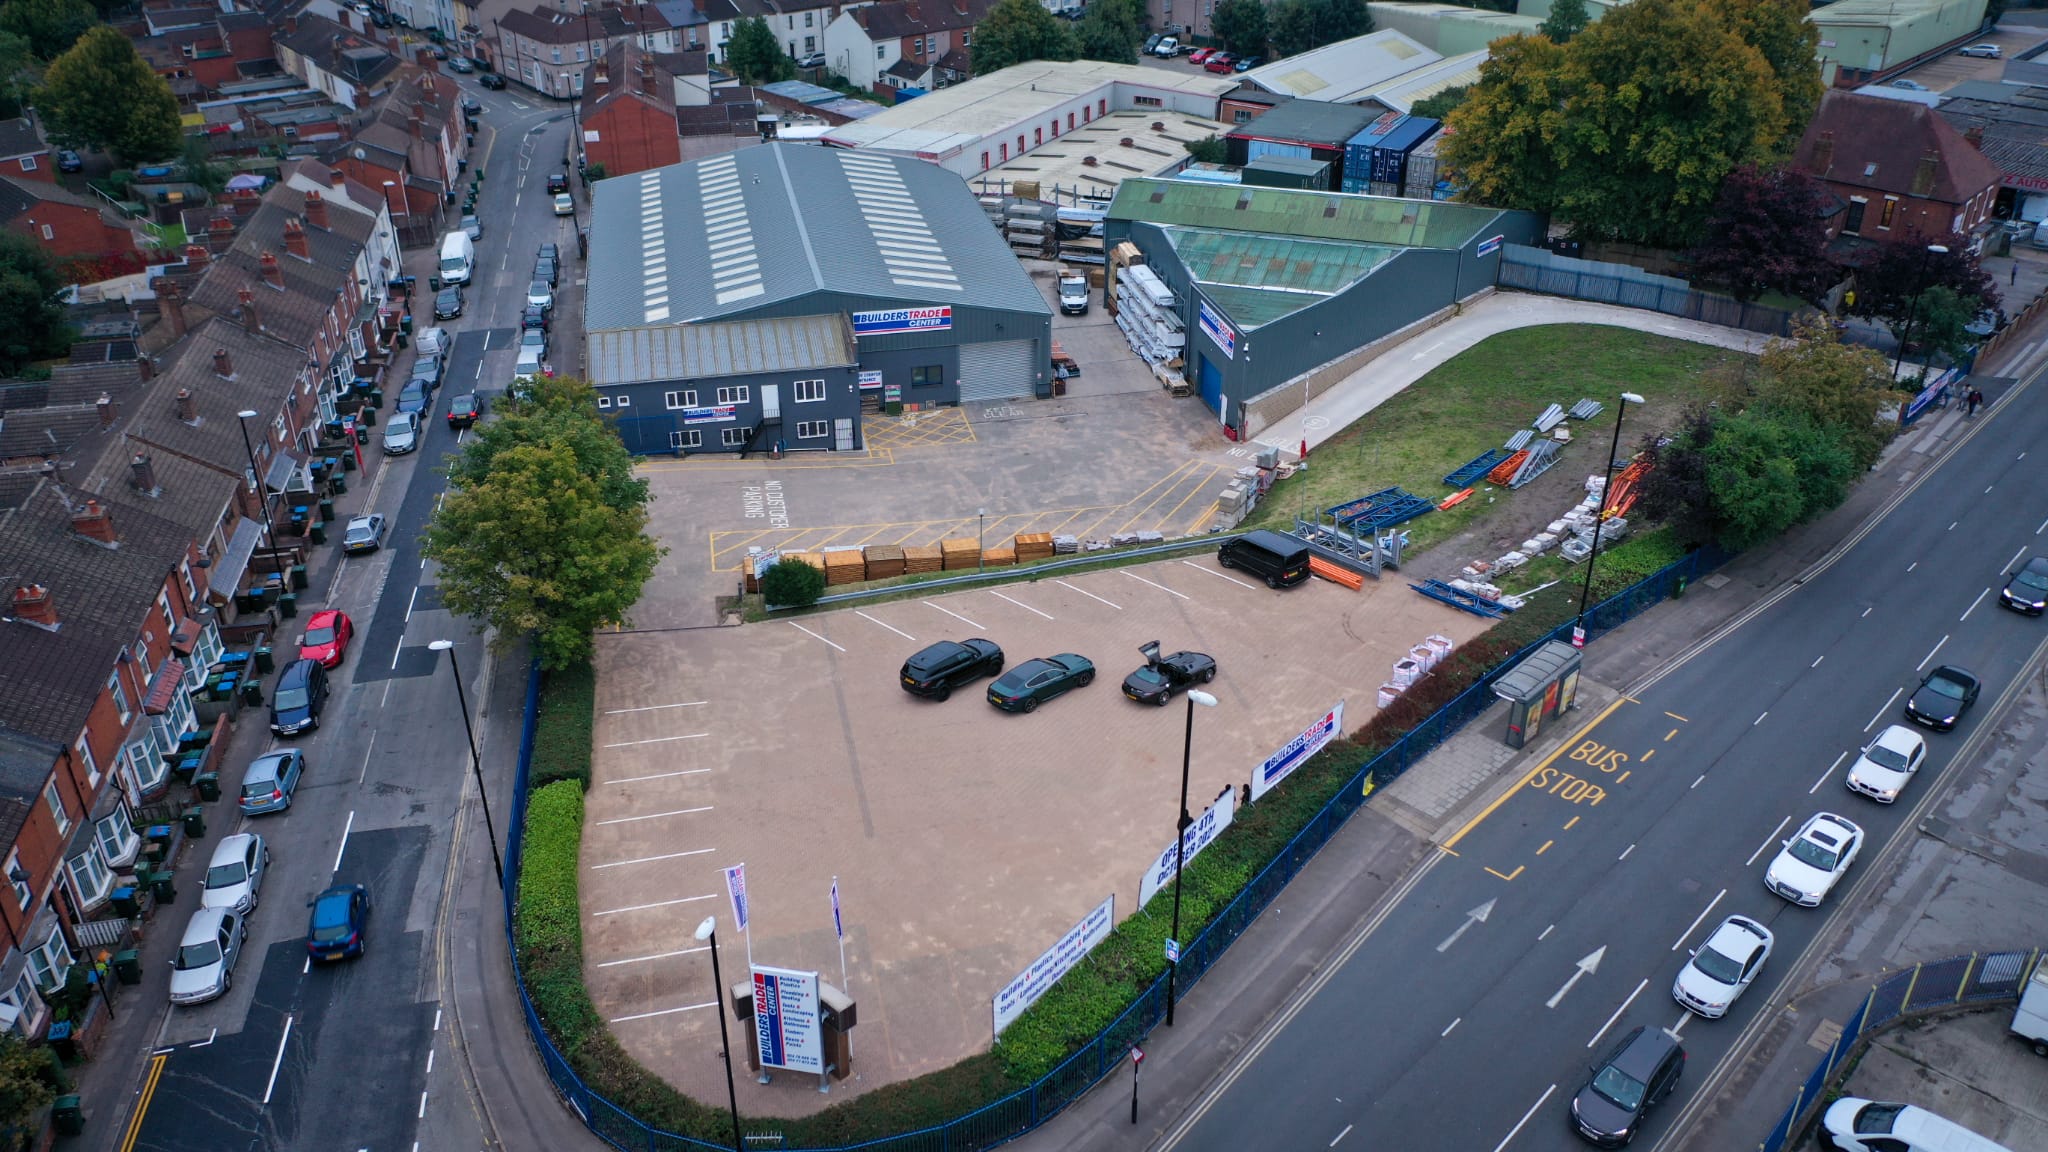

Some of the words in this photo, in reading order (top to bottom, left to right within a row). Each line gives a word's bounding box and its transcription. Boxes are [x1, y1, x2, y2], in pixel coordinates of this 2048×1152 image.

[908, 318, 941, 327] CENTER
[1226, 447, 1248, 457] NO
[764, 480, 783, 490] NO
[742, 486, 765, 518] PARKING
[766, 492, 789, 528] CUSTOMER
[1569, 740, 1629, 773] BUS
[1530, 768, 1604, 806] STOP
[1199, 809, 1215, 831] 4TH
[1032, 954, 1053, 976] Plastics
[1057, 929, 1081, 954] Plumbing
[766, 985, 777, 1016] CENTER
[1000, 999, 1015, 1015] Tools
